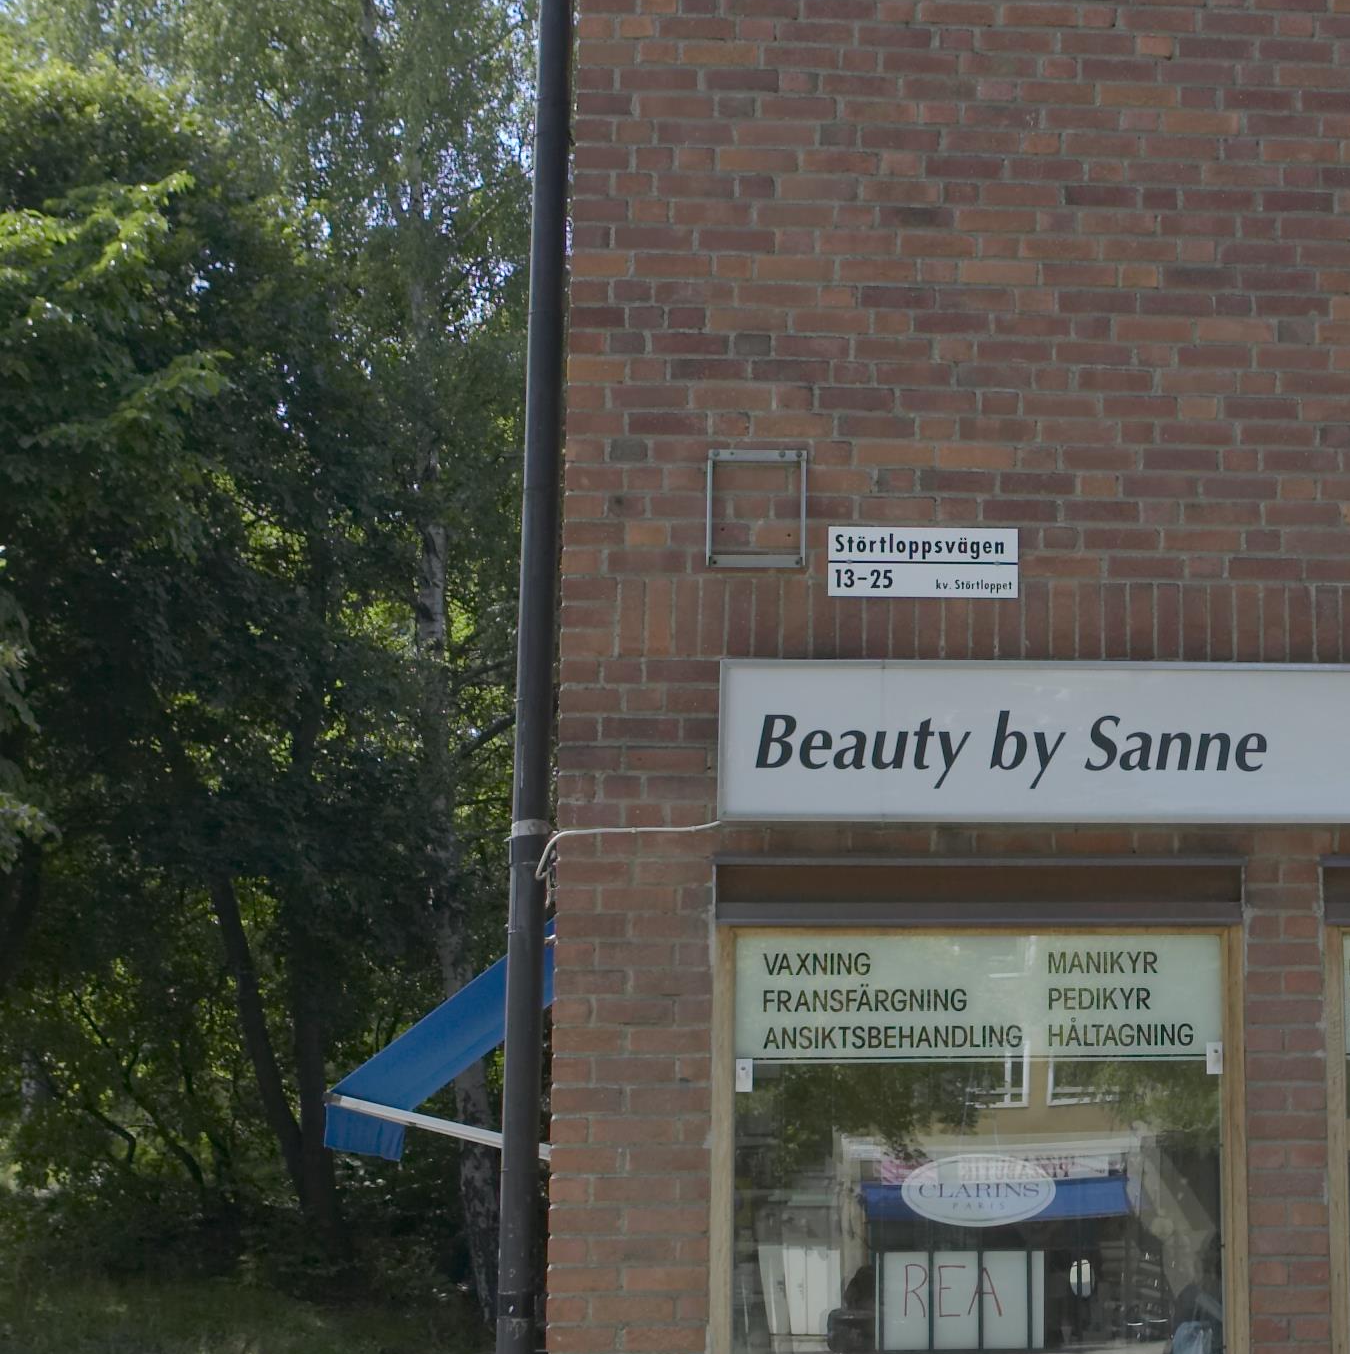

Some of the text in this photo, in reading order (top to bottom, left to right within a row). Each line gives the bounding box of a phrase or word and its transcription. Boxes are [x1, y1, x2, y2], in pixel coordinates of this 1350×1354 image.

[835, 533, 1005, 560] Störtloppsvägen
[835, 568, 893, 589] 13-25
[935, 579, 1012, 594] kv. Störtloppet
[755, 710, 1268, 790] Beauty by Sanne
[763, 952, 871, 976] VAXNING
[1048, 951, 1158, 974] MANIKYR
[763, 984, 967, 1013] FRANSFÄRGNING
[1048, 987, 1151, 1010] PEDIKYR
[763, 1025, 1023, 1050] ANSIKTSBEHANDLING
[1048, 1017, 1194, 1047] HÅLTAGNING
[918, 1182, 1040, 1198] CLARINS
[951, 1201, 1005, 1211] PARIS
[904, 1262, 1004, 1319] REA
